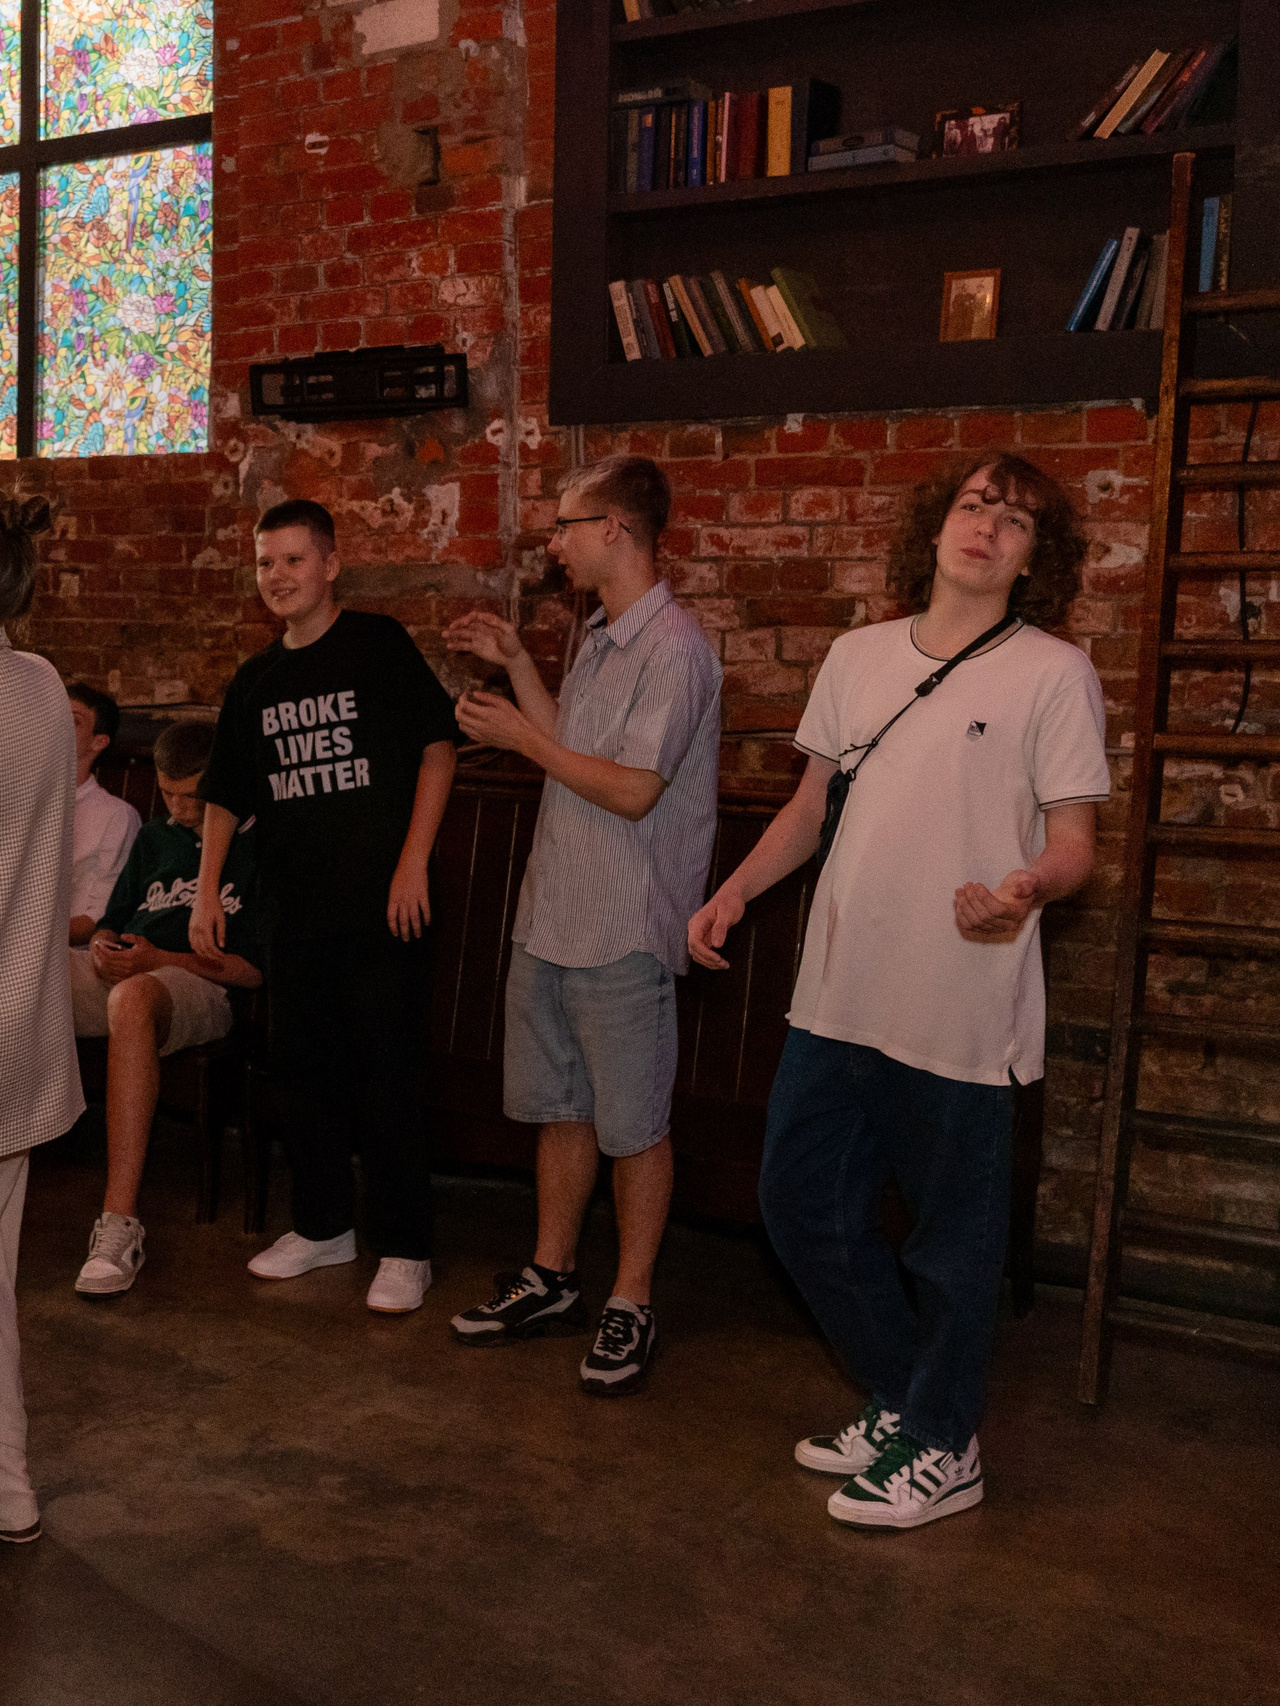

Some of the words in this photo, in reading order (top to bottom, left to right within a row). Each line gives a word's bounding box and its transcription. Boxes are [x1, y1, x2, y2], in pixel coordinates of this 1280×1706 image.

[262, 690, 359, 736] BROKE
[274, 726, 354, 766] LIVES
[268, 757, 371, 802] MATTER
